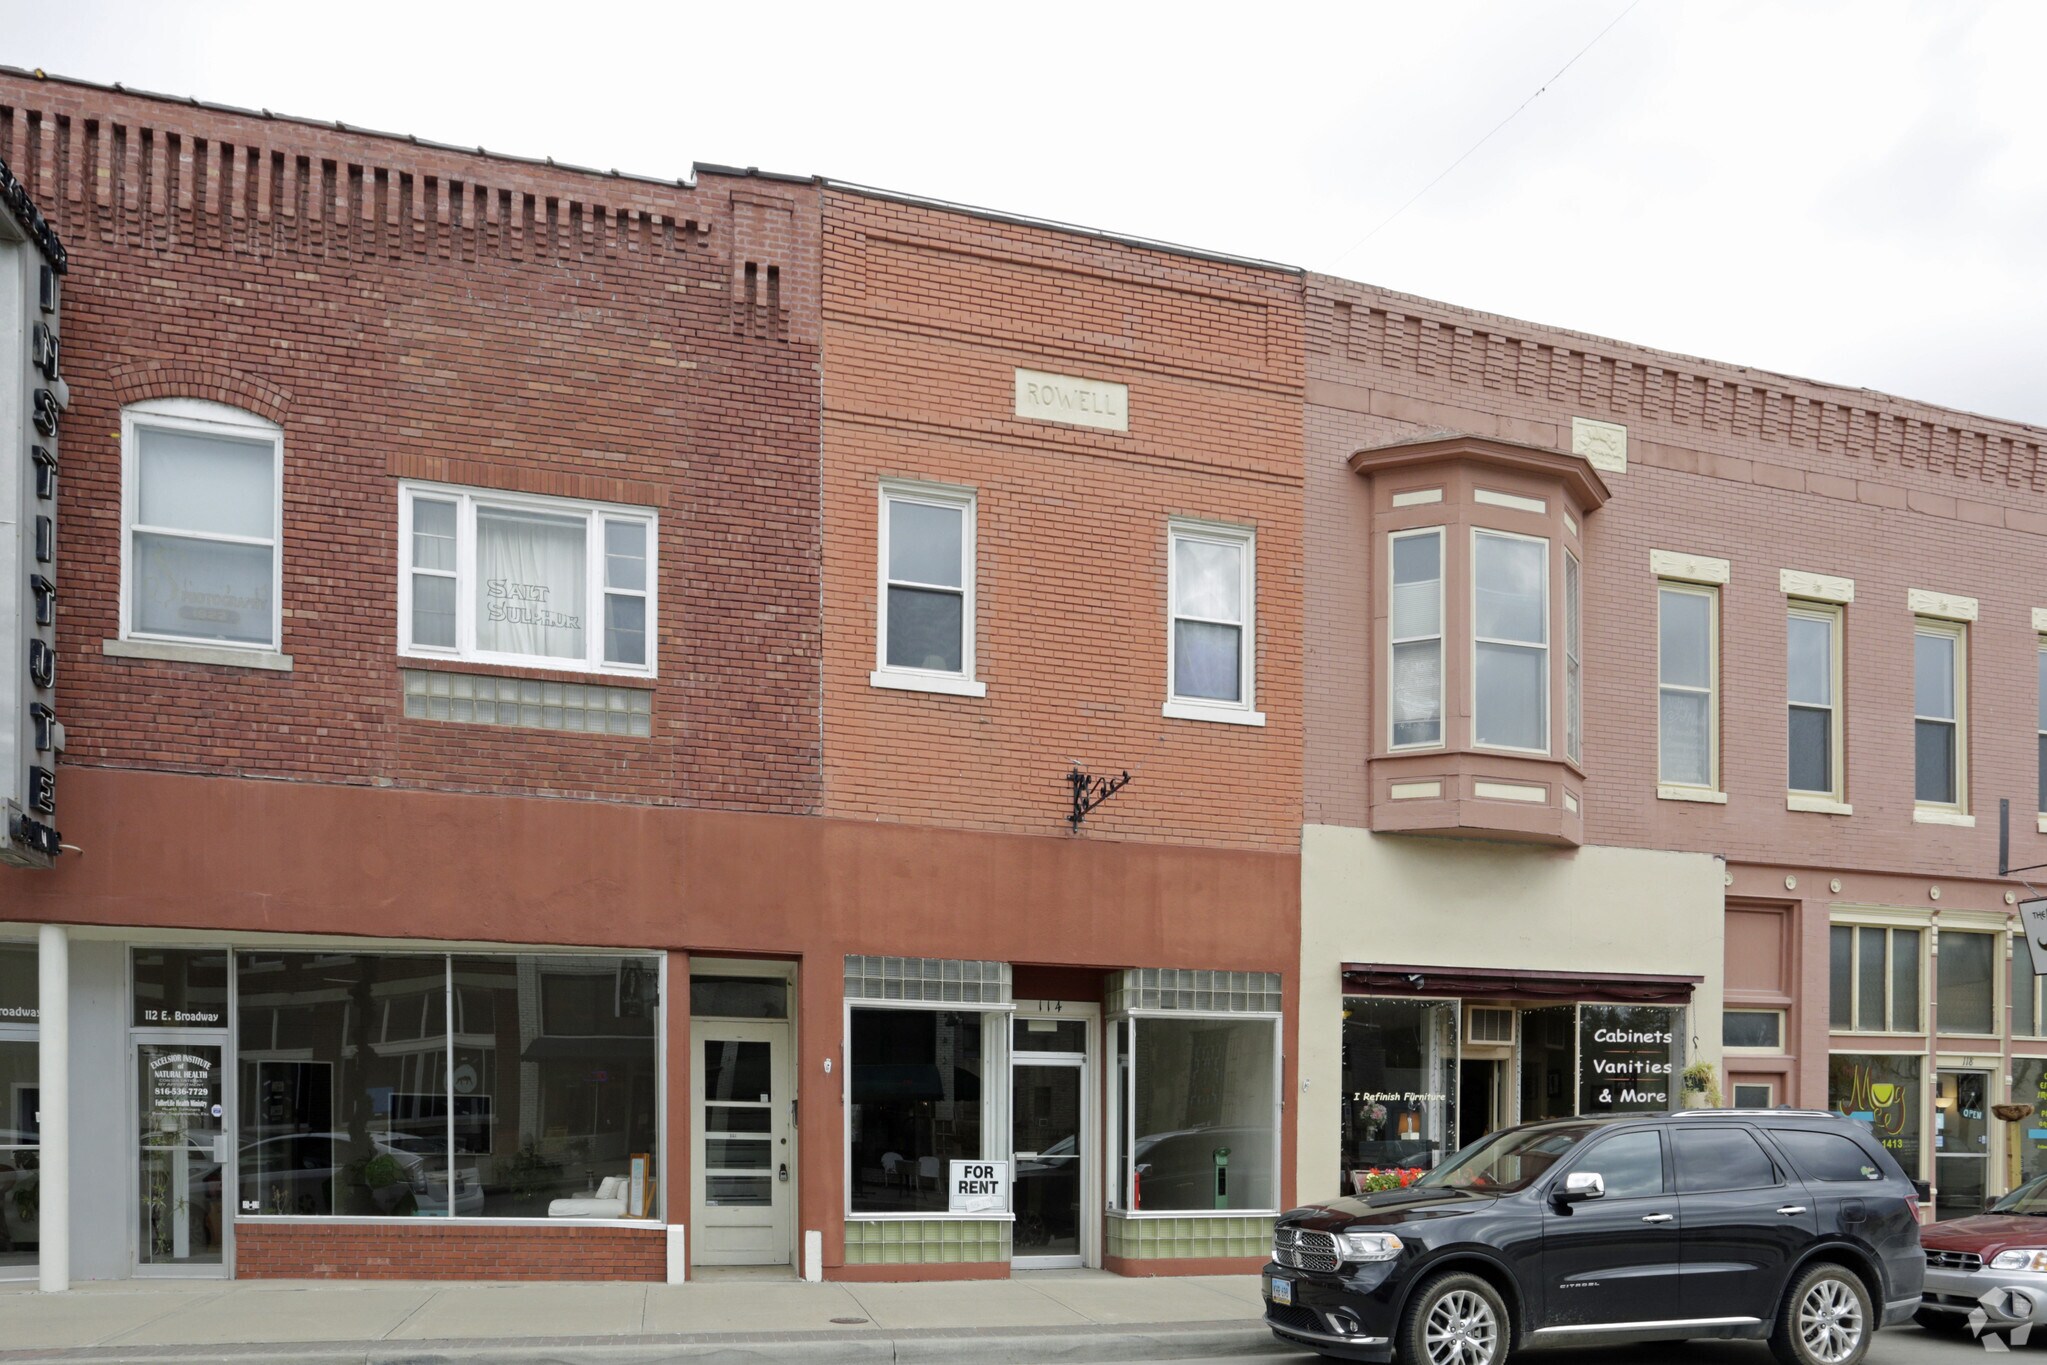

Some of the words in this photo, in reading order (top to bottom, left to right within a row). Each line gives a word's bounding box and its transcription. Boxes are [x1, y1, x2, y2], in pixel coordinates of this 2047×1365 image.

[1027, 382, 1116, 415] ROWELL
[486, 578, 550, 603] SALT
[145, 1010, 158, 1020] 112
[161, 1010, 172, 1020] E.
[174, 1011, 219, 1022] Broadway
[1594, 1028, 1673, 1043] Cabinets
[150, 1054, 182, 1070] EXCELSIOR
[182, 1054, 212, 1071] INSTITUTE
[1593, 1059, 1673, 1074] Vanities
[1962, 1056, 1974, 1066] 118
[154, 1070, 182, 1078] NATURAL
[183, 1070, 208, 1079] HEALTH
[154, 1087, 209, 1096] 816-536-7729
[1353, 1092, 1361, 1101] I
[1363, 1092, 1401, 1101] Refinish
[1404, 1092, 1446, 1101] Furniture
[1598, 1088, 1612, 1103] &
[1619, 1088, 1667, 1103] More
[1962, 1109, 1982, 1119] OPEN
[964, 1165, 994, 1179] FOR
[958, 1180, 999, 1194] RENT
